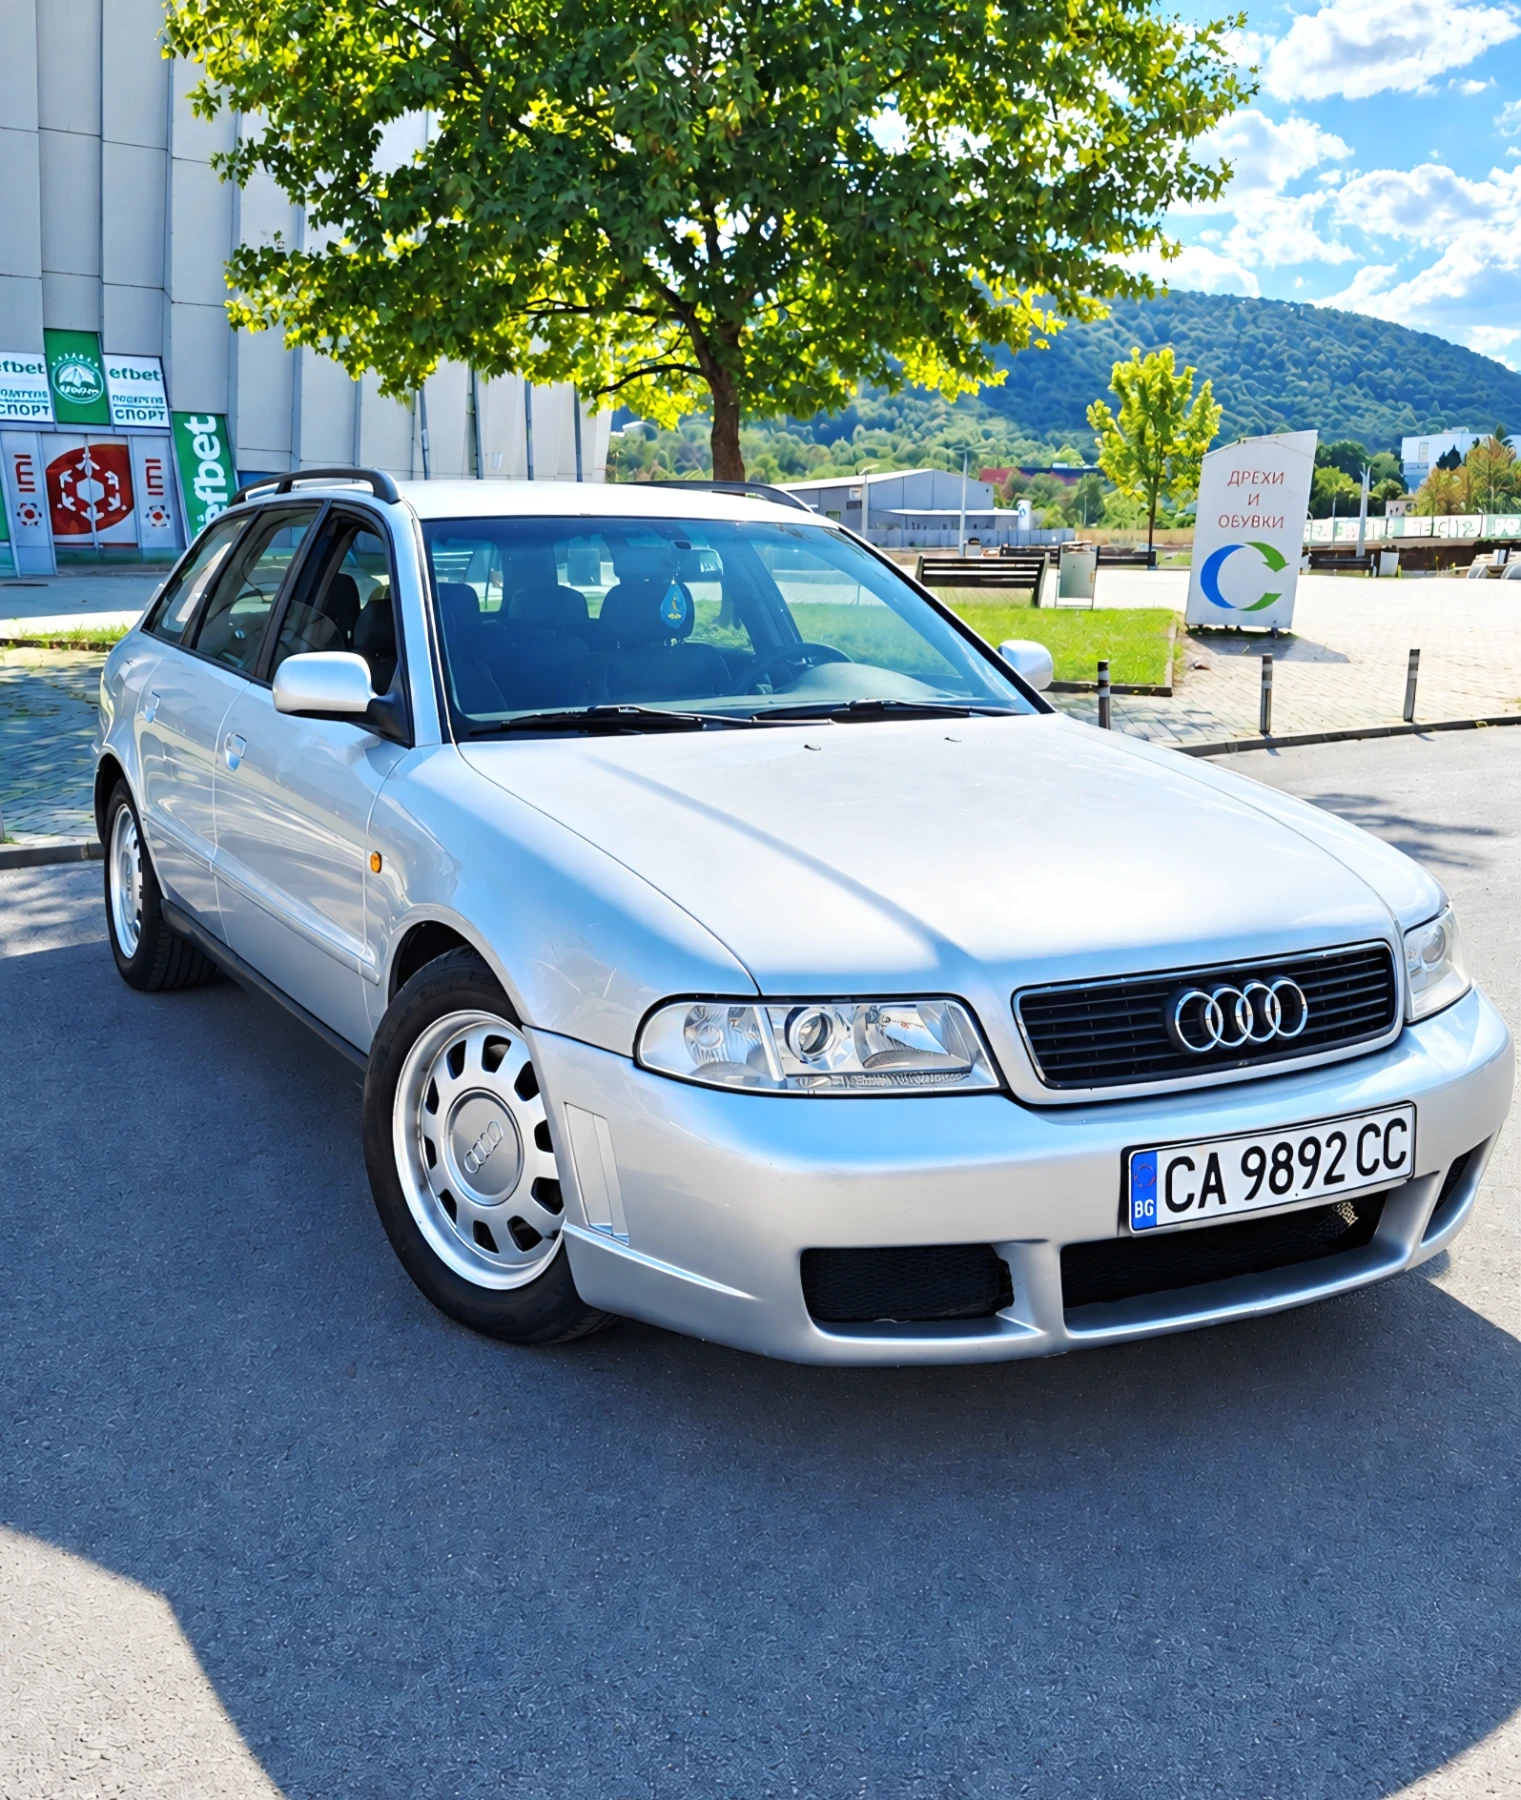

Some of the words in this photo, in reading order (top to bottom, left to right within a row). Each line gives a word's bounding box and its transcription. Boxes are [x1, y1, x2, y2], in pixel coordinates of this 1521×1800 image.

[0, 360, 46, 375] fbet
[109, 368, 161, 381] efbet
[0, 404, 50, 416] СПОРТ
[115, 409, 166, 421] СПОРТ
[1226, 470, 1286, 487] ДРЕХИ
[1247, 492, 1260, 507] И
[1217, 515, 1285, 529] ОБУВКИ
[1164, 1152, 1227, 1214] CA
[1240, 1131, 1348, 1202] 9892
[1356, 1117, 1408, 1177] CC
[1134, 1199, 1155, 1219] BG
